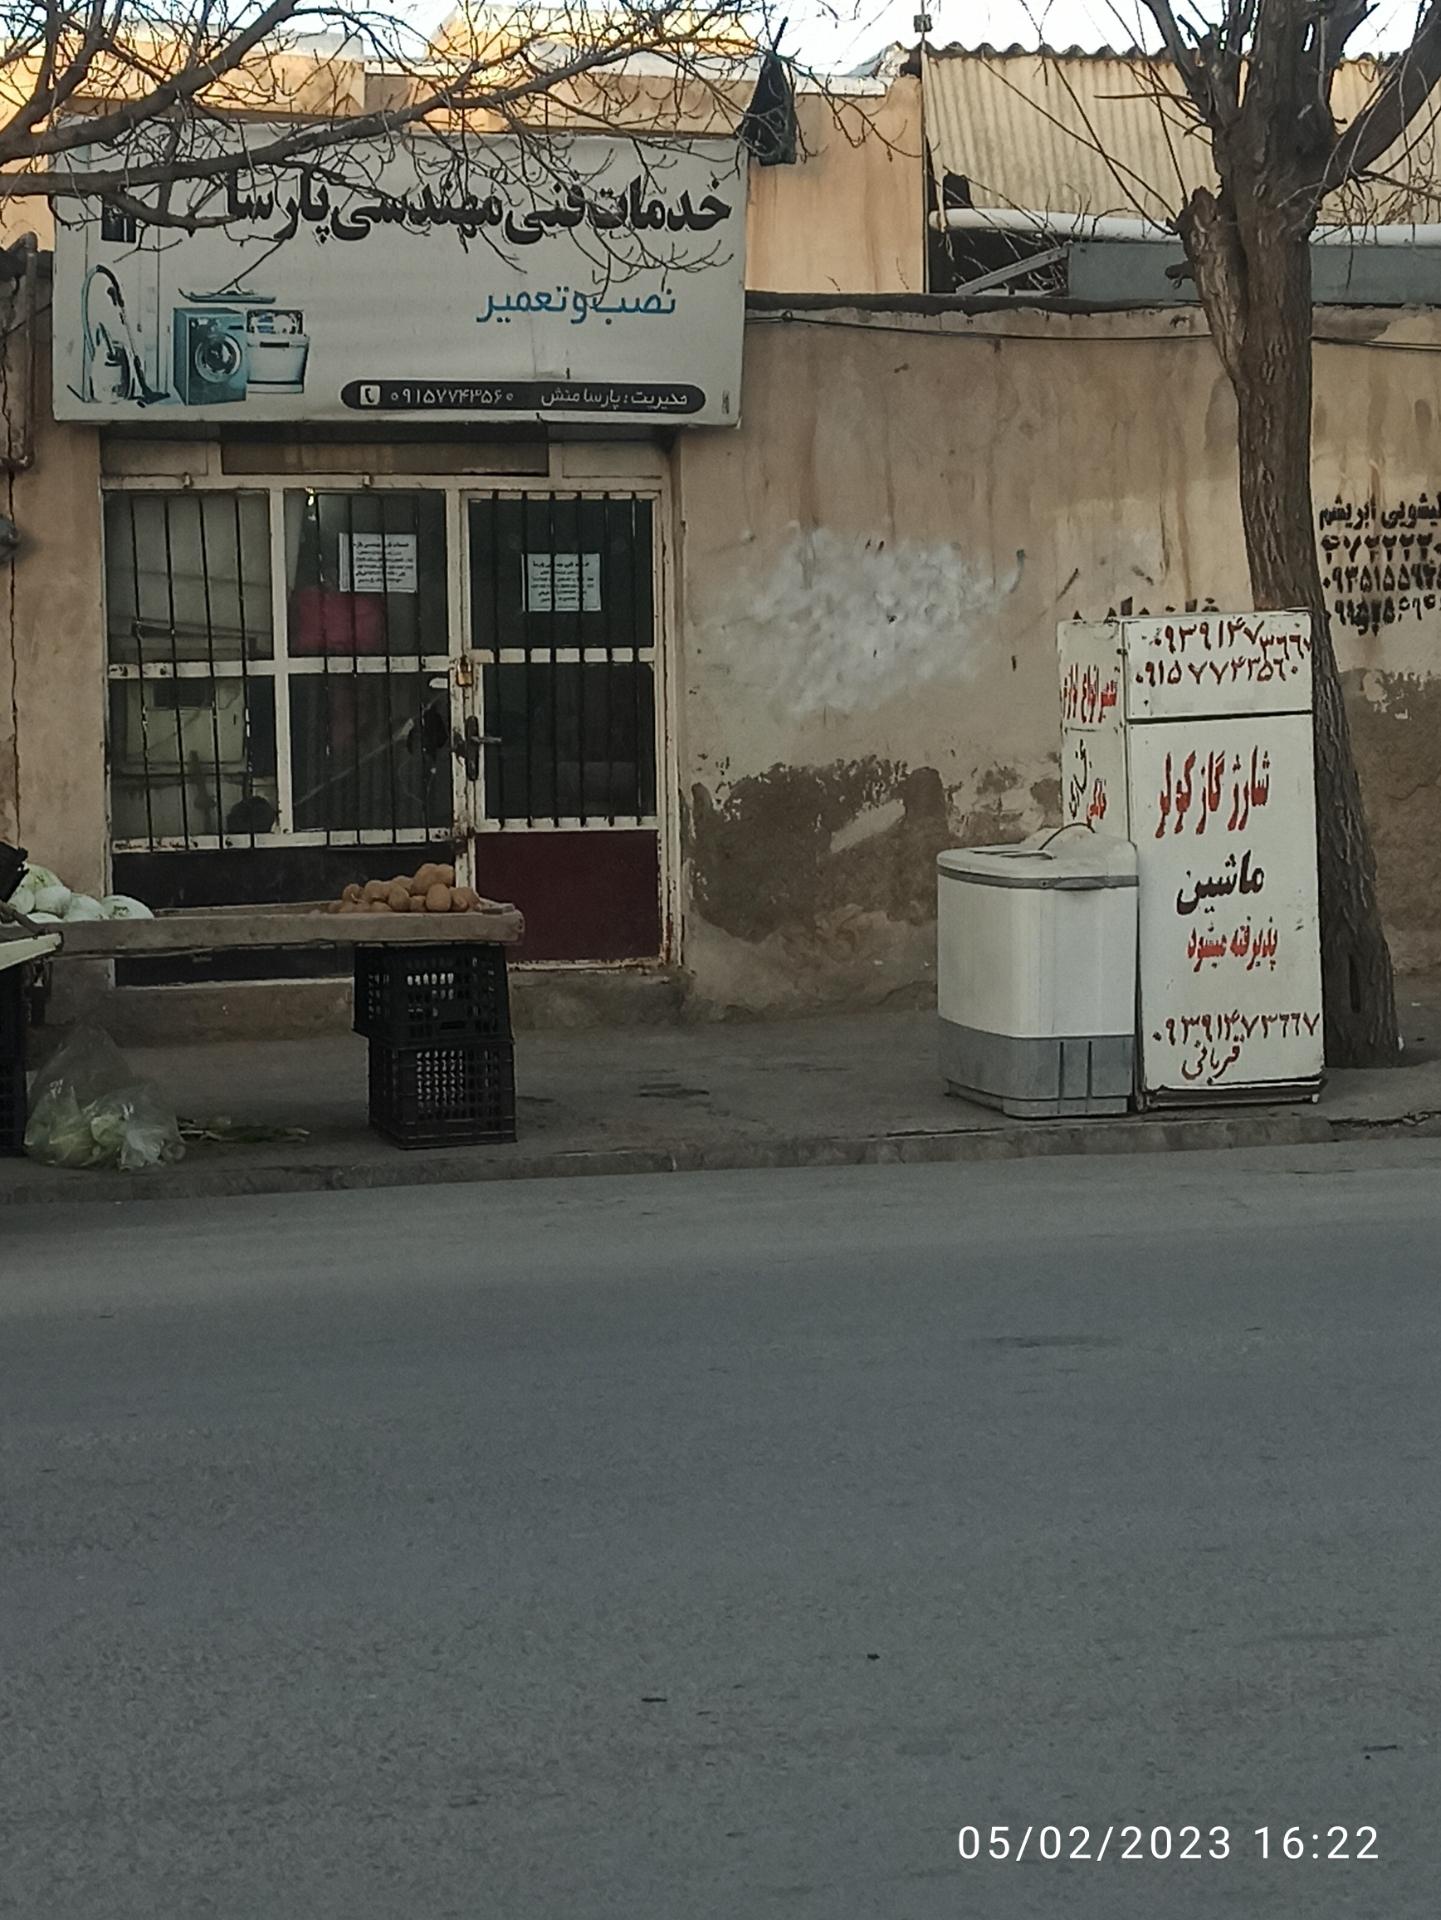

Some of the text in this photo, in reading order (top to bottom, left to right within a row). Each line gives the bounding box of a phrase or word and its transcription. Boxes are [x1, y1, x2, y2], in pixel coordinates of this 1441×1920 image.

[227, 167, 732, 246] خدمات فنی مهندسی پارسا
[475, 286, 677, 326] نصب و تعمیر
[1154, 749, 1197, 839] کولر
[1195, 749, 1226, 835] گاز
[1227, 744, 1271, 832] شارژ
[1176, 849, 1265, 916] ماشین
